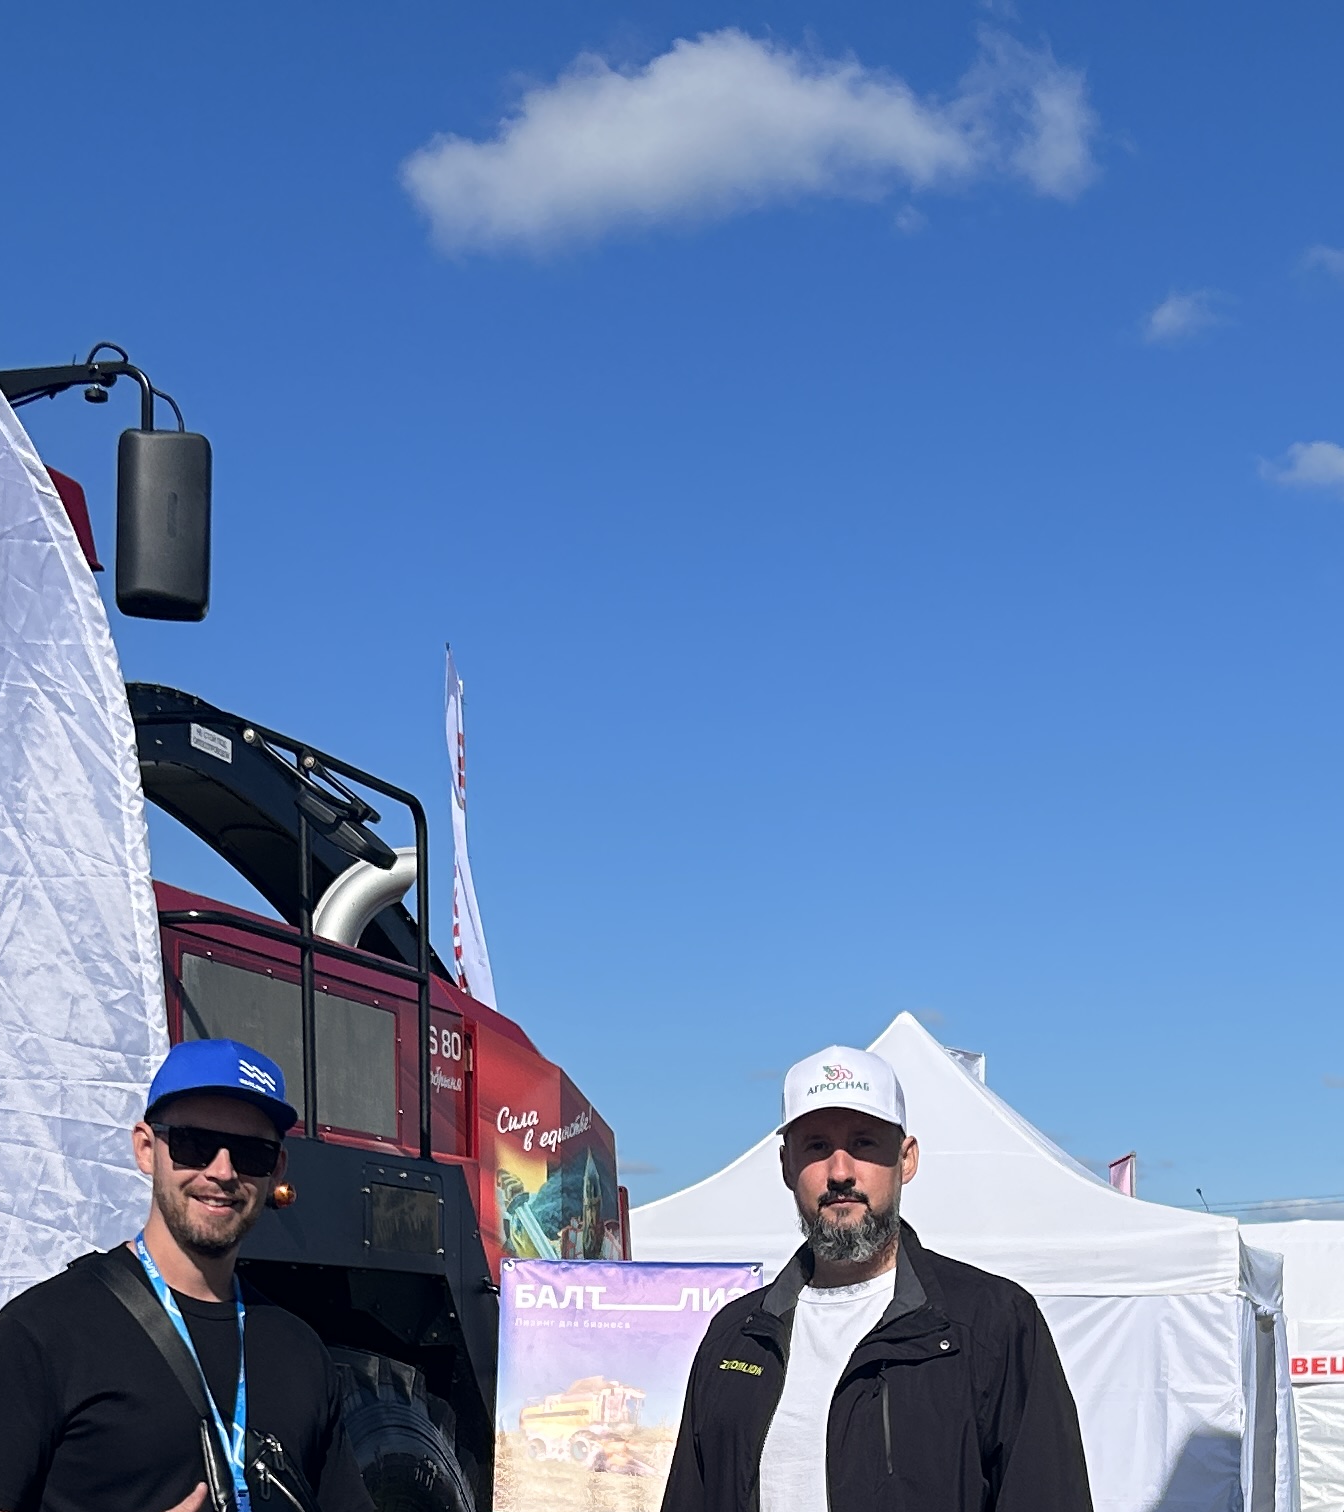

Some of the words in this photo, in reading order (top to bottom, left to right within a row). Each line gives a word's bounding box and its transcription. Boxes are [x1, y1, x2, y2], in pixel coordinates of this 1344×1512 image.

[441, 1029, 462, 1061] 80
[807, 1081, 870, 1096] АГРОСНАБ
[497, 1106, 539, 1134] Сила
[523, 1128, 533, 1151] в
[539, 1104, 592, 1152] единстве!
[514, 1318, 556, 1327] Лизинг
[559, 1320, 580, 1329] для
[583, 1319, 631, 1329] бизнеса
